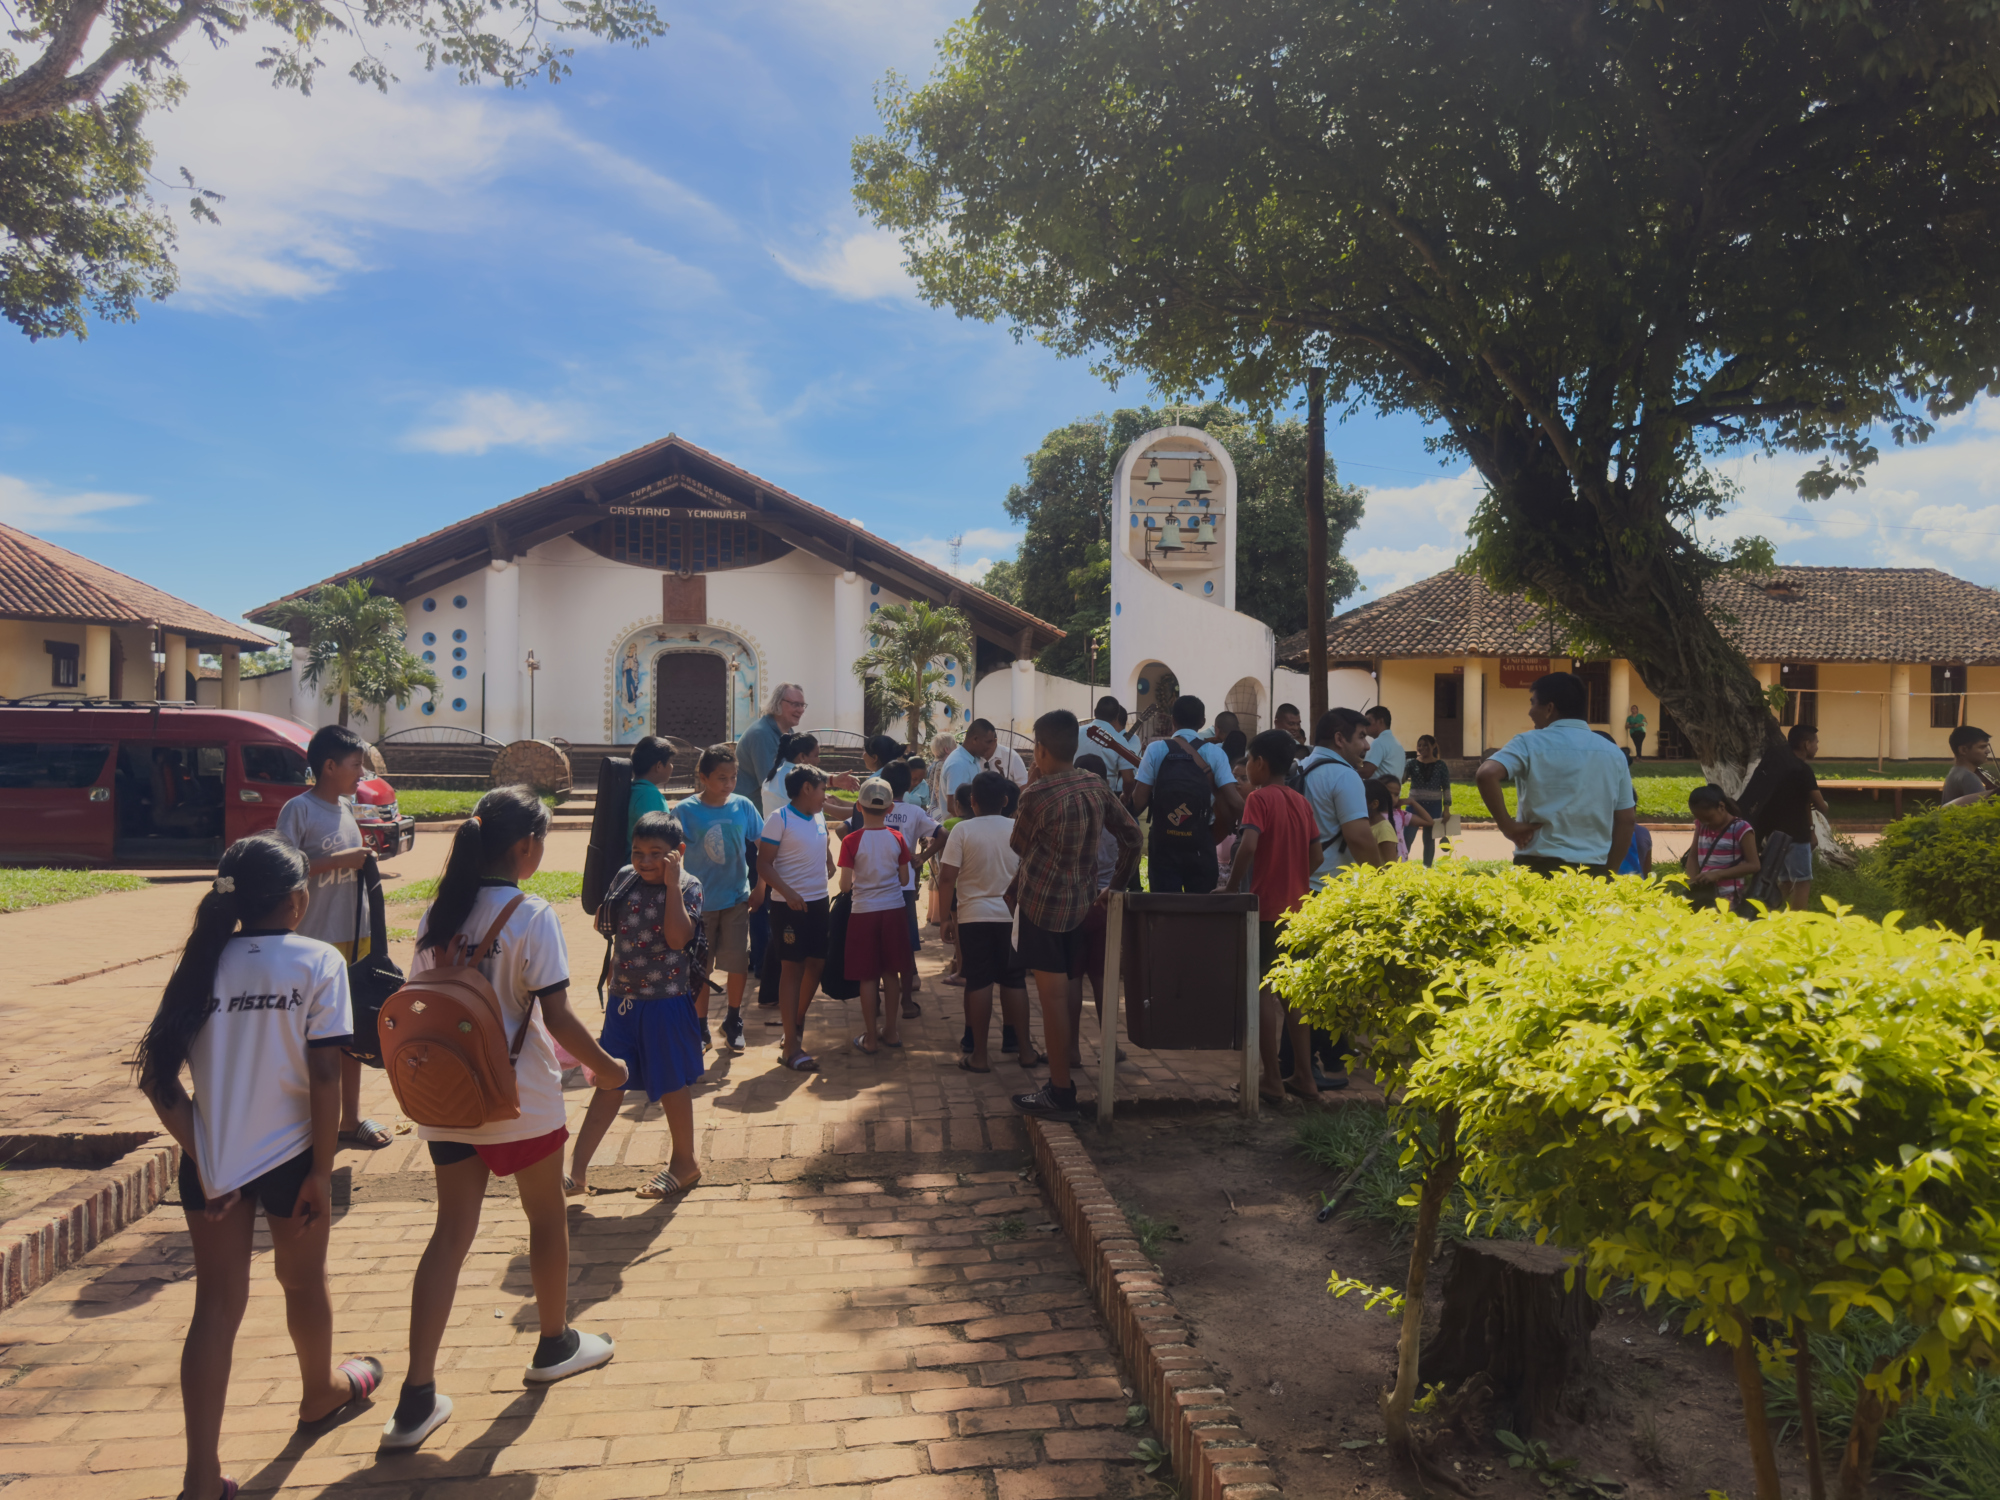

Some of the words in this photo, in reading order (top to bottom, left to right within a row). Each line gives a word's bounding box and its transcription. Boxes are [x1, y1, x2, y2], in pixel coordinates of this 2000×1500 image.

[681, 474, 702, 490] CASA
[703, 485, 713, 495] DE
[715, 490, 732, 504] DIOS
[609, 506, 670, 517] CRISTIANO
[885, 813, 907, 823] ZARD
[1167, 802, 1193, 826] CAT
[227, 990, 287, 1013] FÍSICA
